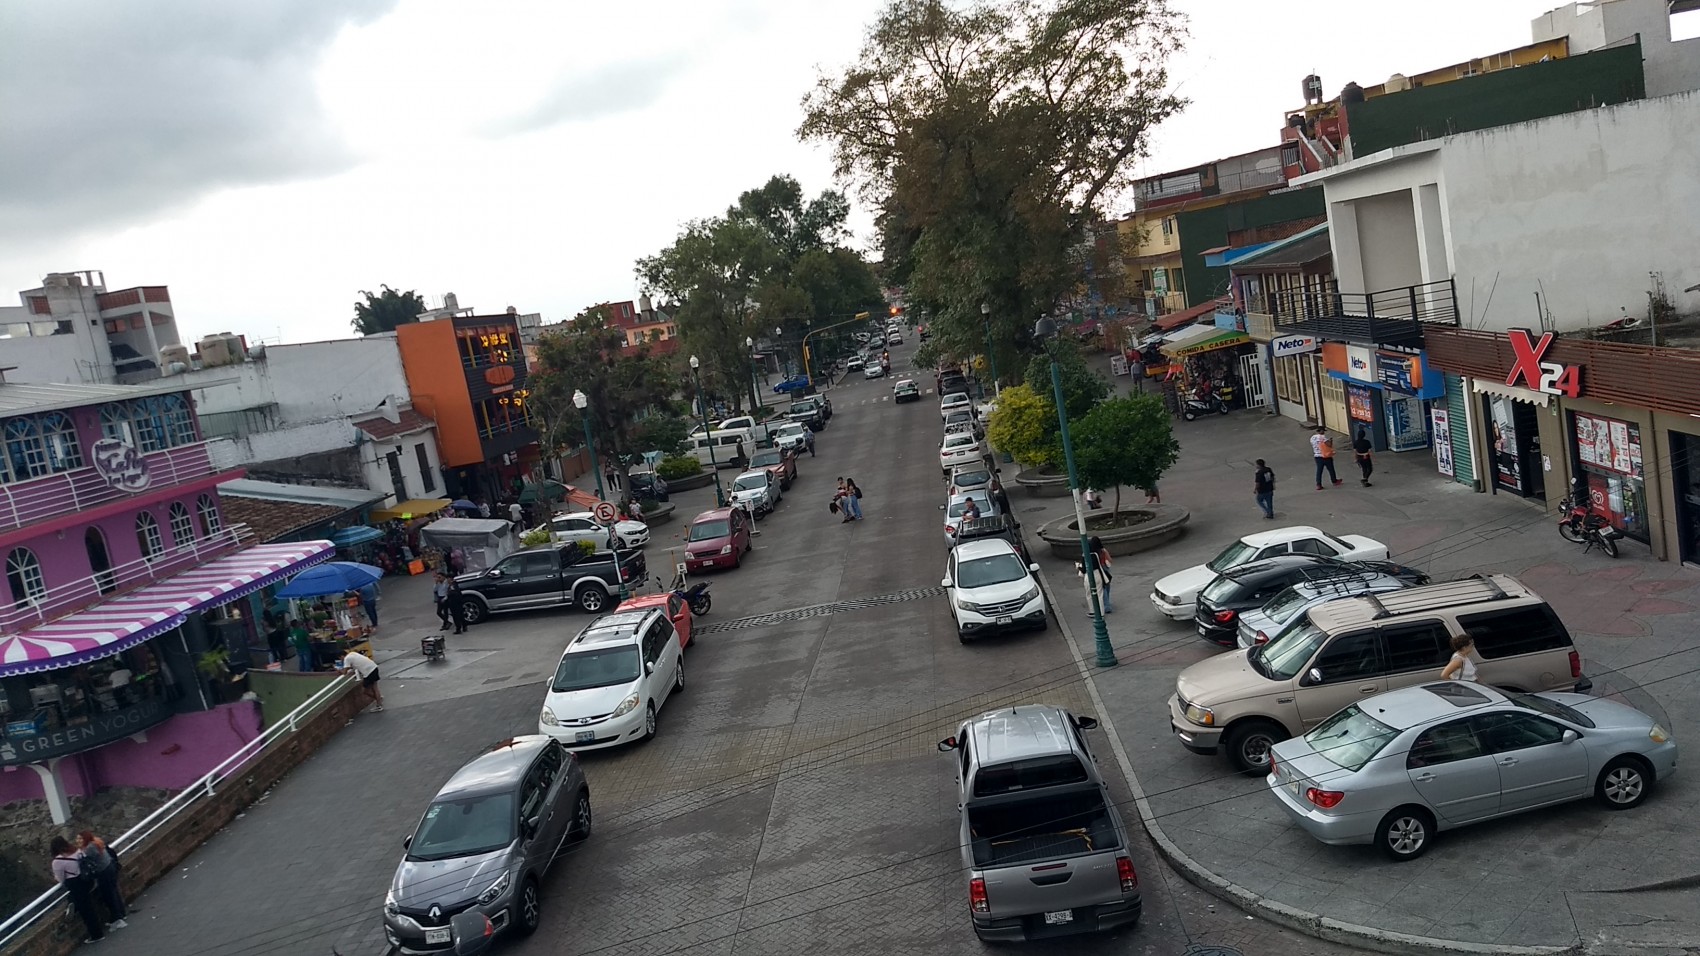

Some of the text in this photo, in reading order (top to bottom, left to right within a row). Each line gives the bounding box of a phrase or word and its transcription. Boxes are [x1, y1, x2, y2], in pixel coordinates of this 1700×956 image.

[1176, 337, 1241, 356] COMIDA CASERA
[1277, 338, 1305, 351] Neto
[1350, 355, 1364, 370] Neto
[1506, 328, 1582, 398] X24
[22, 724, 95, 752] GREEN
